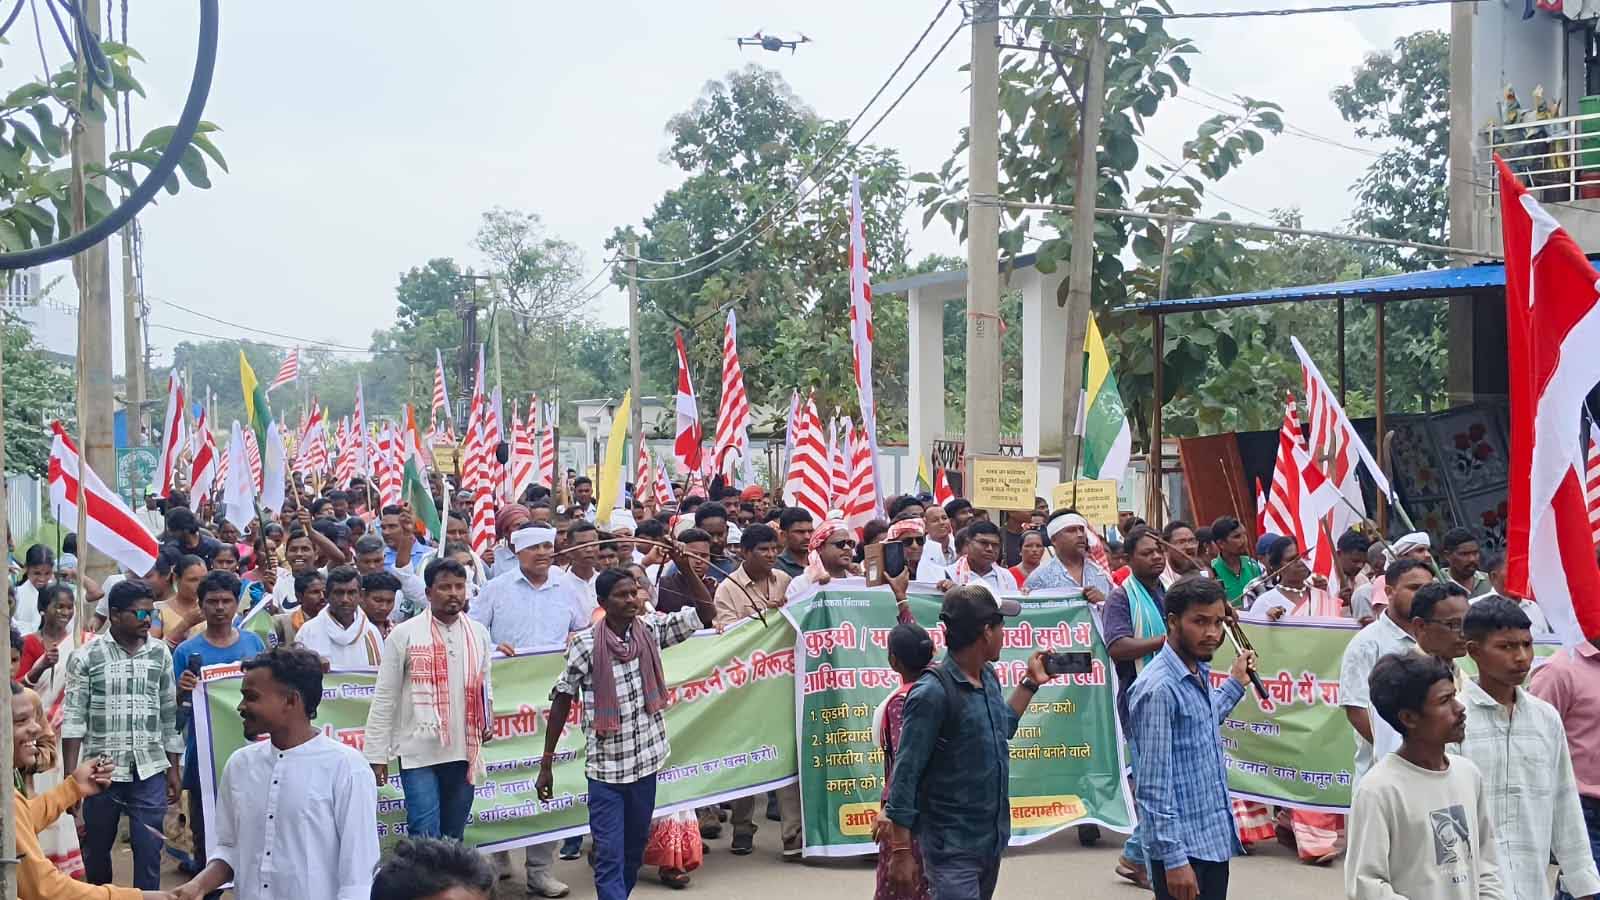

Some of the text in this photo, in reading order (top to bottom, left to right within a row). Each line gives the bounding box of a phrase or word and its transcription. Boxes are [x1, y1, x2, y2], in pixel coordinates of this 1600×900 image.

[1073, 622, 1091, 647] में
[725, 656, 747, 687] के
[1298, 674, 1314, 705] में
[852, 703, 869, 718] को
[1068, 742, 1091, 758] वाले
[826, 778, 856, 794] कानून
[860, 774, 876, 789] को
[1301, 771, 1333, 789] कानून
